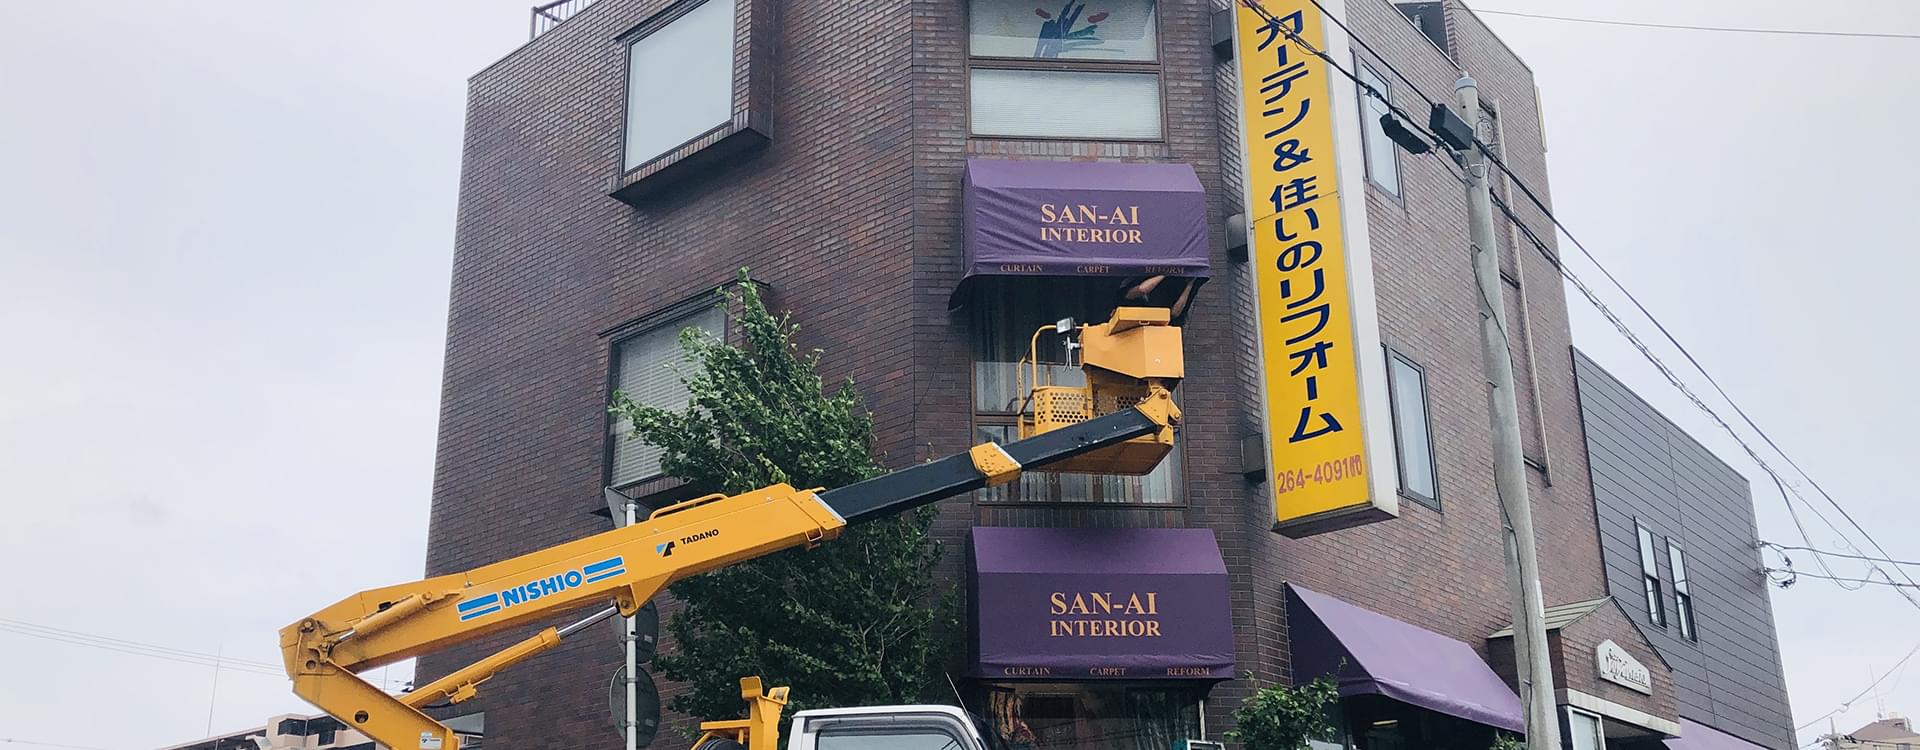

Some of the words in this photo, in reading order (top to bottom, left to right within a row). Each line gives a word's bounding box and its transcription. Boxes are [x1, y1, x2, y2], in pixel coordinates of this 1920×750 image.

[1040, 203, 1140, 225] SAN-AI
[1040, 227, 1143, 244] INTERIOR
[1256, 9, 1344, 444] カーテン&住いのリフォーム
[1000, 263, 1044, 273] CURTAIN
[1076, 265, 1111, 274] CARPET
[1144, 265, 1185, 275] REFORM
[680, 528, 720, 545] TADANO
[502, 570, 583, 607] NISHIO
[1050, 591, 1158, 616] SAN-AI
[1049, 619, 1162, 637] INTERIOR
[1003, 666, 1051, 676] CURTAIN
[1089, 666, 1127, 677] CARPET
[1166, 666, 1210, 677] REFORM
